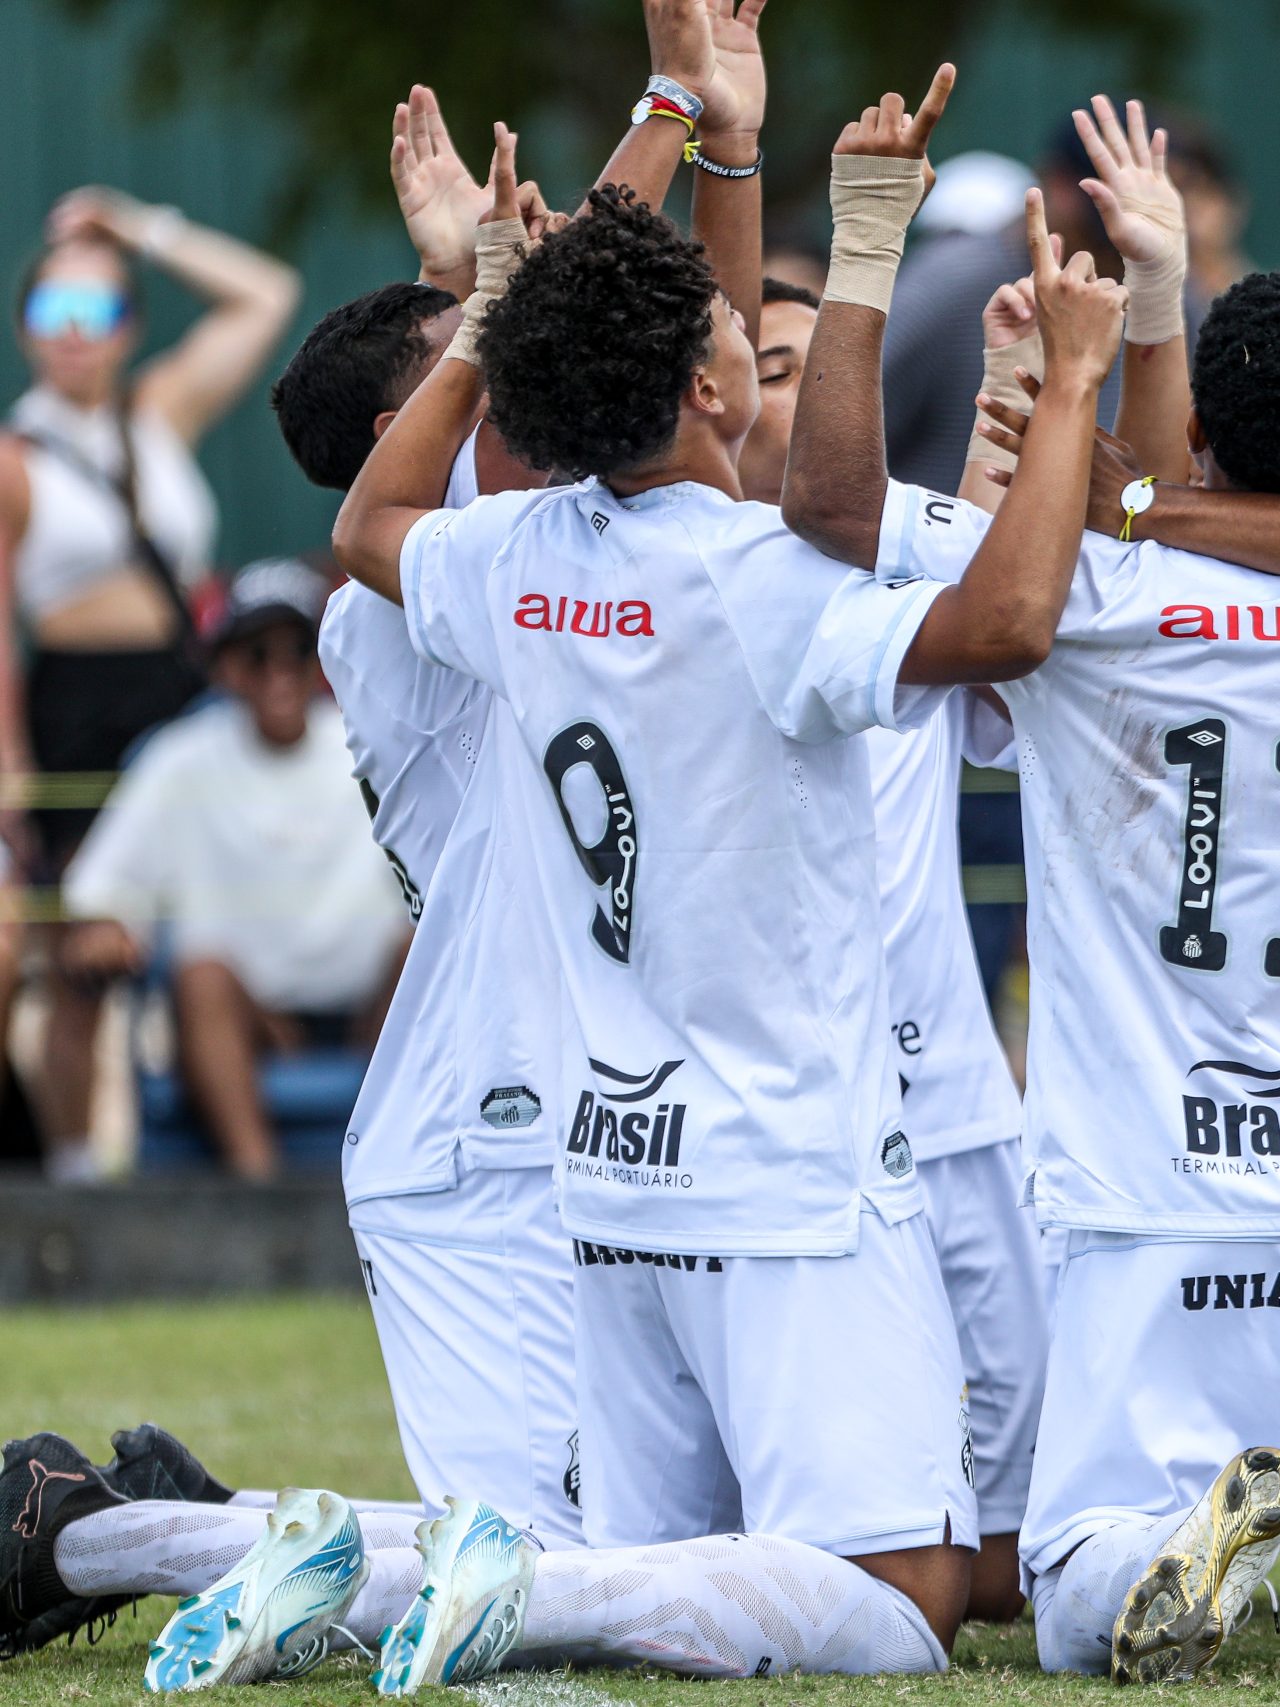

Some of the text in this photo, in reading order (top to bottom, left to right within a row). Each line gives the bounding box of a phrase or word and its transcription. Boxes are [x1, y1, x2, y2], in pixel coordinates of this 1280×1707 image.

[513, 593, 655, 637] aiwa
[542, 717, 638, 965] 9
[1183, 790, 1217, 909] LOOVI
[566, 1090, 687, 1167] Brasil
[612, 1168, 693, 1188] PORTUÁRIO
[1171, 1158, 1268, 1176] TERMINAL
